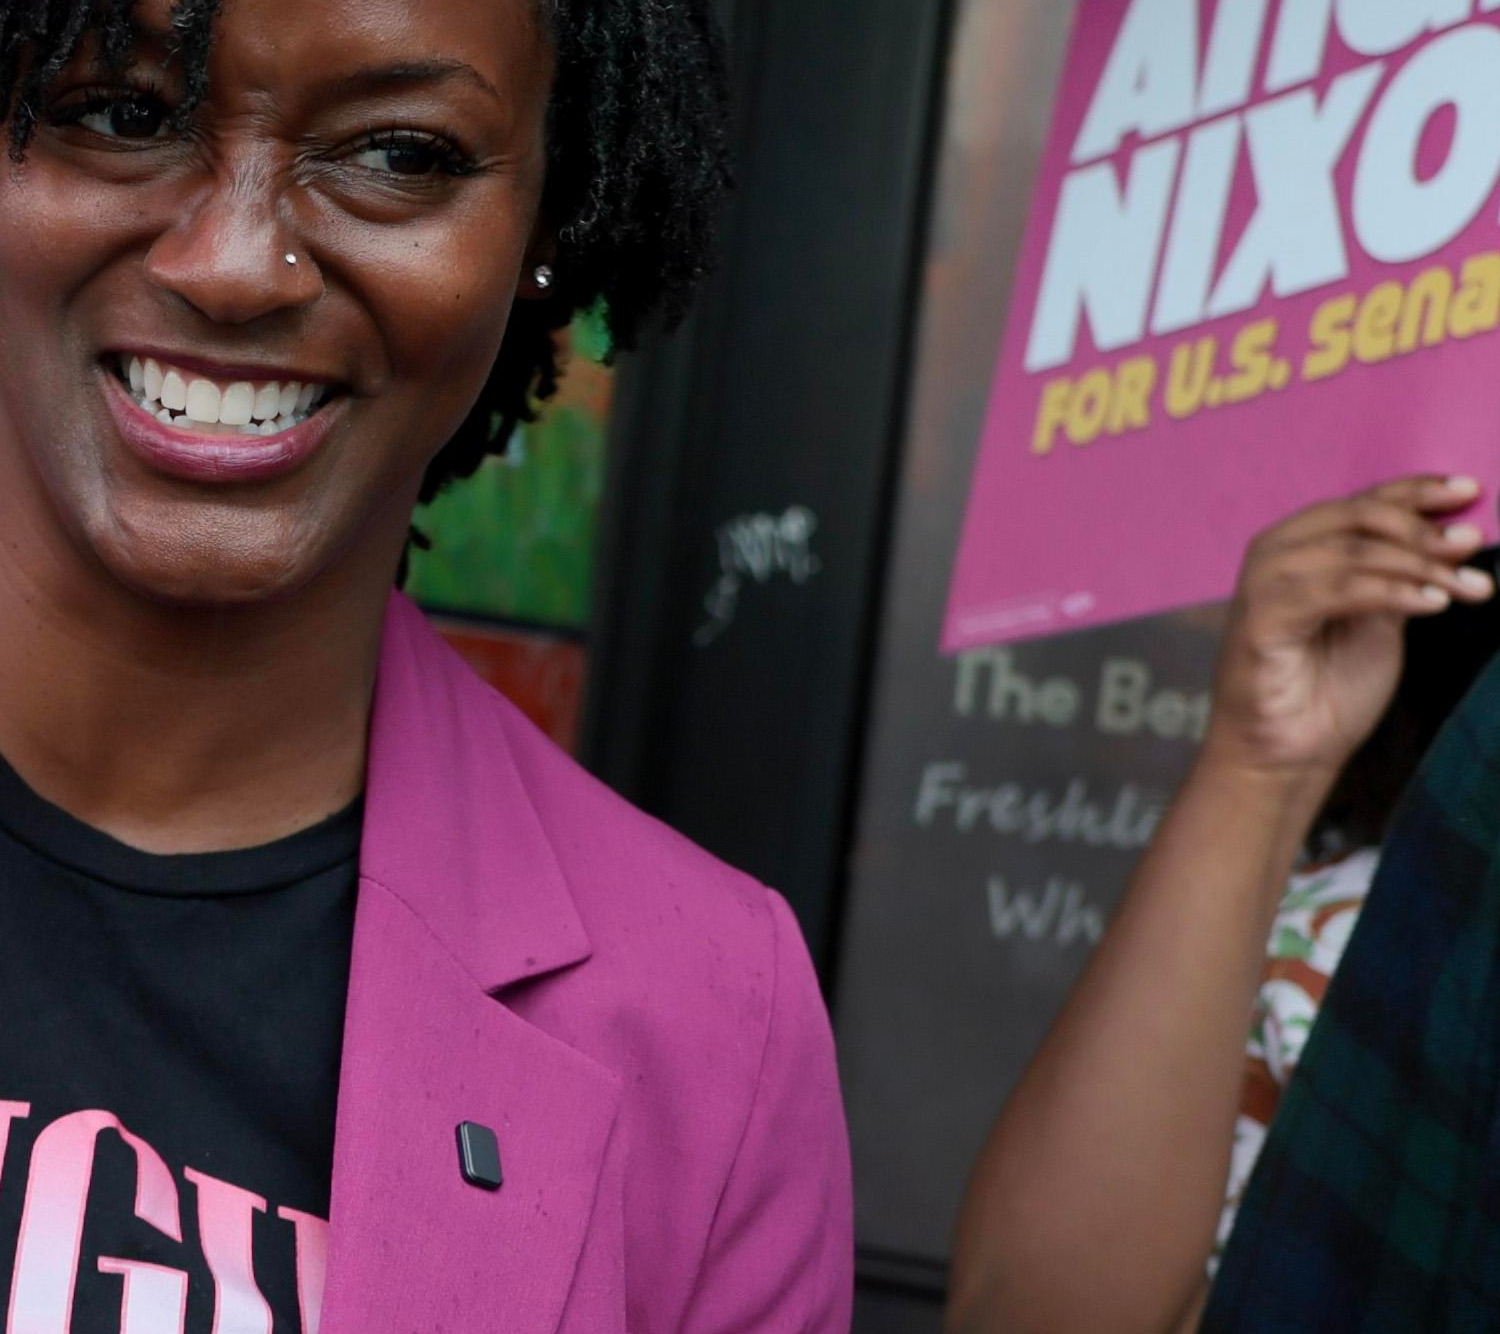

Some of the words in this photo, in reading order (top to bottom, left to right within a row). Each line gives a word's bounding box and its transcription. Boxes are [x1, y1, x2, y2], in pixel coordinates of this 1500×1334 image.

[1030, 357, 1154, 456] FOR
[1164, 320, 1293, 418] U.S.
[953, 647, 1081, 727] The
[1096, 658, 1211, 741] Be
